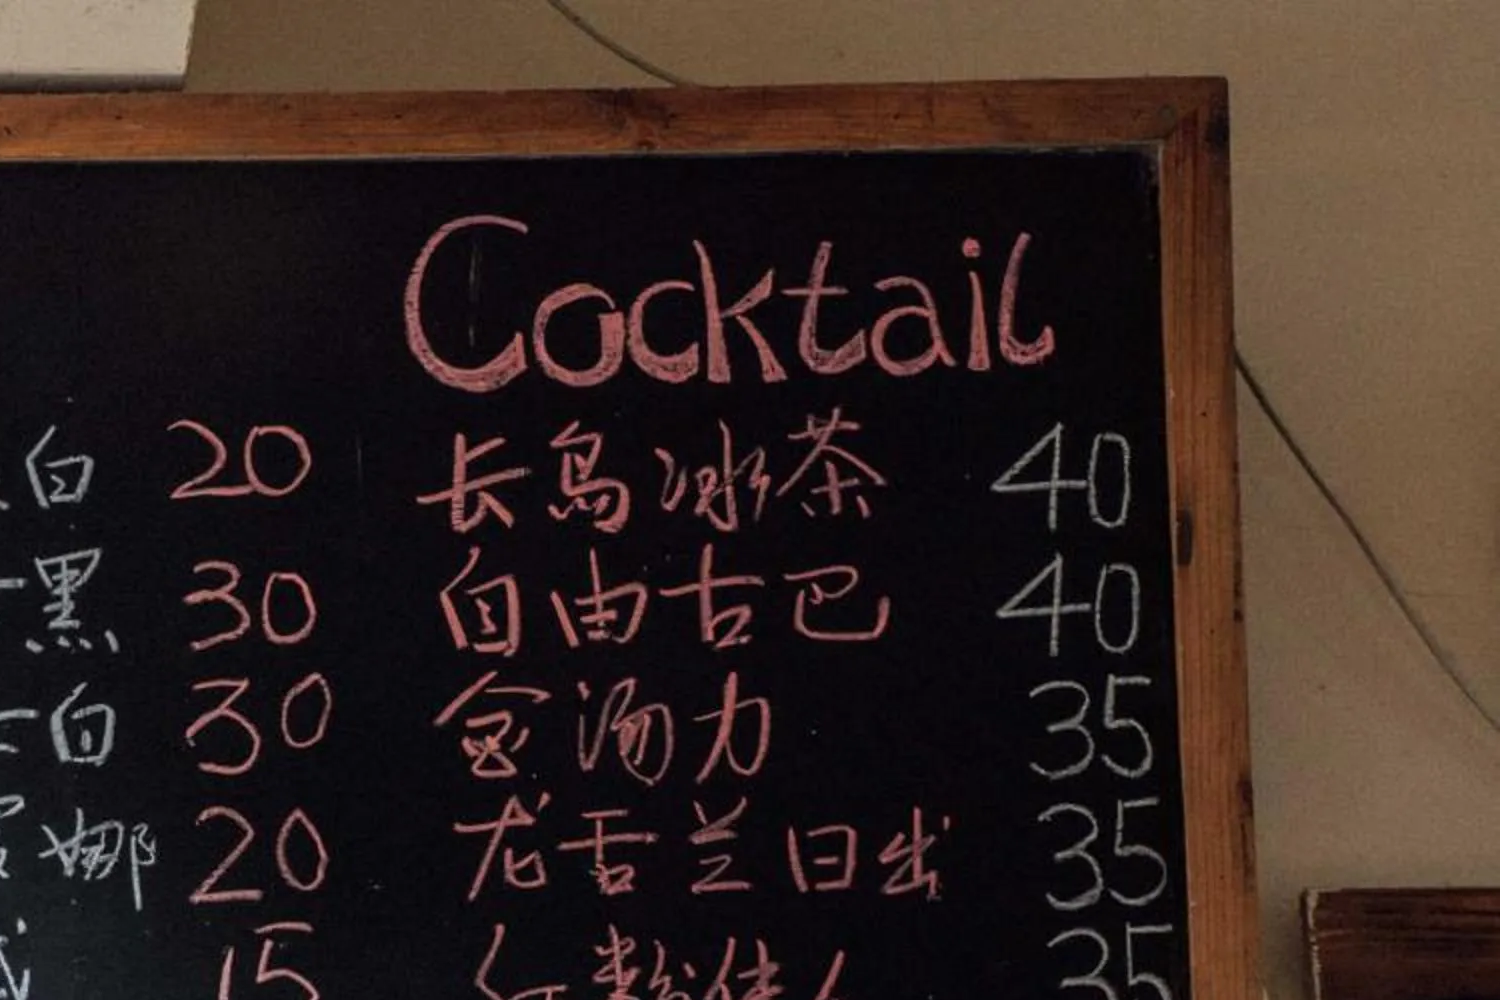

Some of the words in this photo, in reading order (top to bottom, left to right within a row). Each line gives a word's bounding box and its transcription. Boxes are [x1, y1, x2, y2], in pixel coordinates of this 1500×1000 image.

[404, 215, 1055, 393] Cocktail
[167, 419, 312, 499] 20
[991, 422, 1131, 530] 40
[183, 560, 317, 651] 30
[440, 543, 890, 657] 自由古巴
[996, 553, 1140, 656] 40
[185, 672, 332, 775] 30
[433, 671, 771, 786] 金汤力
[1029, 674, 1152, 779] 35
[189, 806, 329, 904] 20
[453, 792, 950, 901] 龙舌兰日出
[1038, 797, 1166, 910] 35
